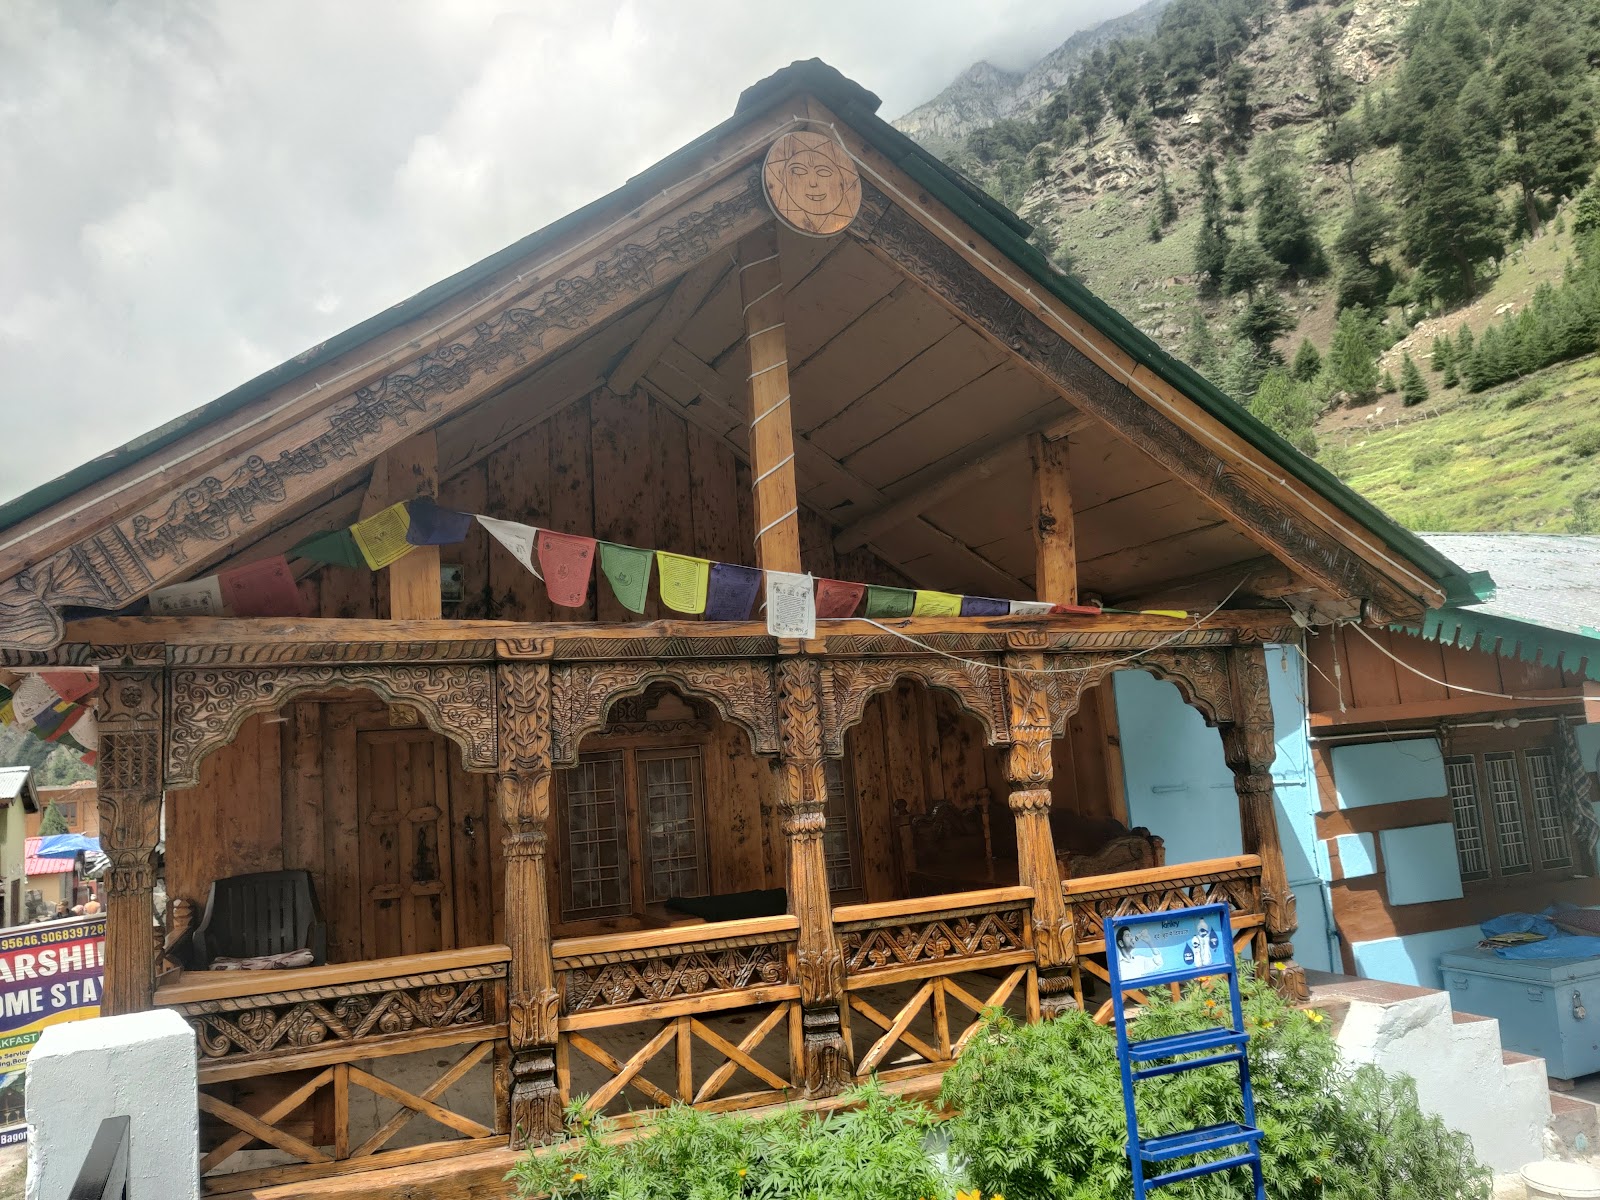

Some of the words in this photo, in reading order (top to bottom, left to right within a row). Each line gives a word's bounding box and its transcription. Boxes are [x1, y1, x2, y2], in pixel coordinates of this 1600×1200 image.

[0, 924, 106, 950] 95646,906839728
[0, 1033, 37, 1048] KFAST
[4, 1050, 31, 1059] Service
